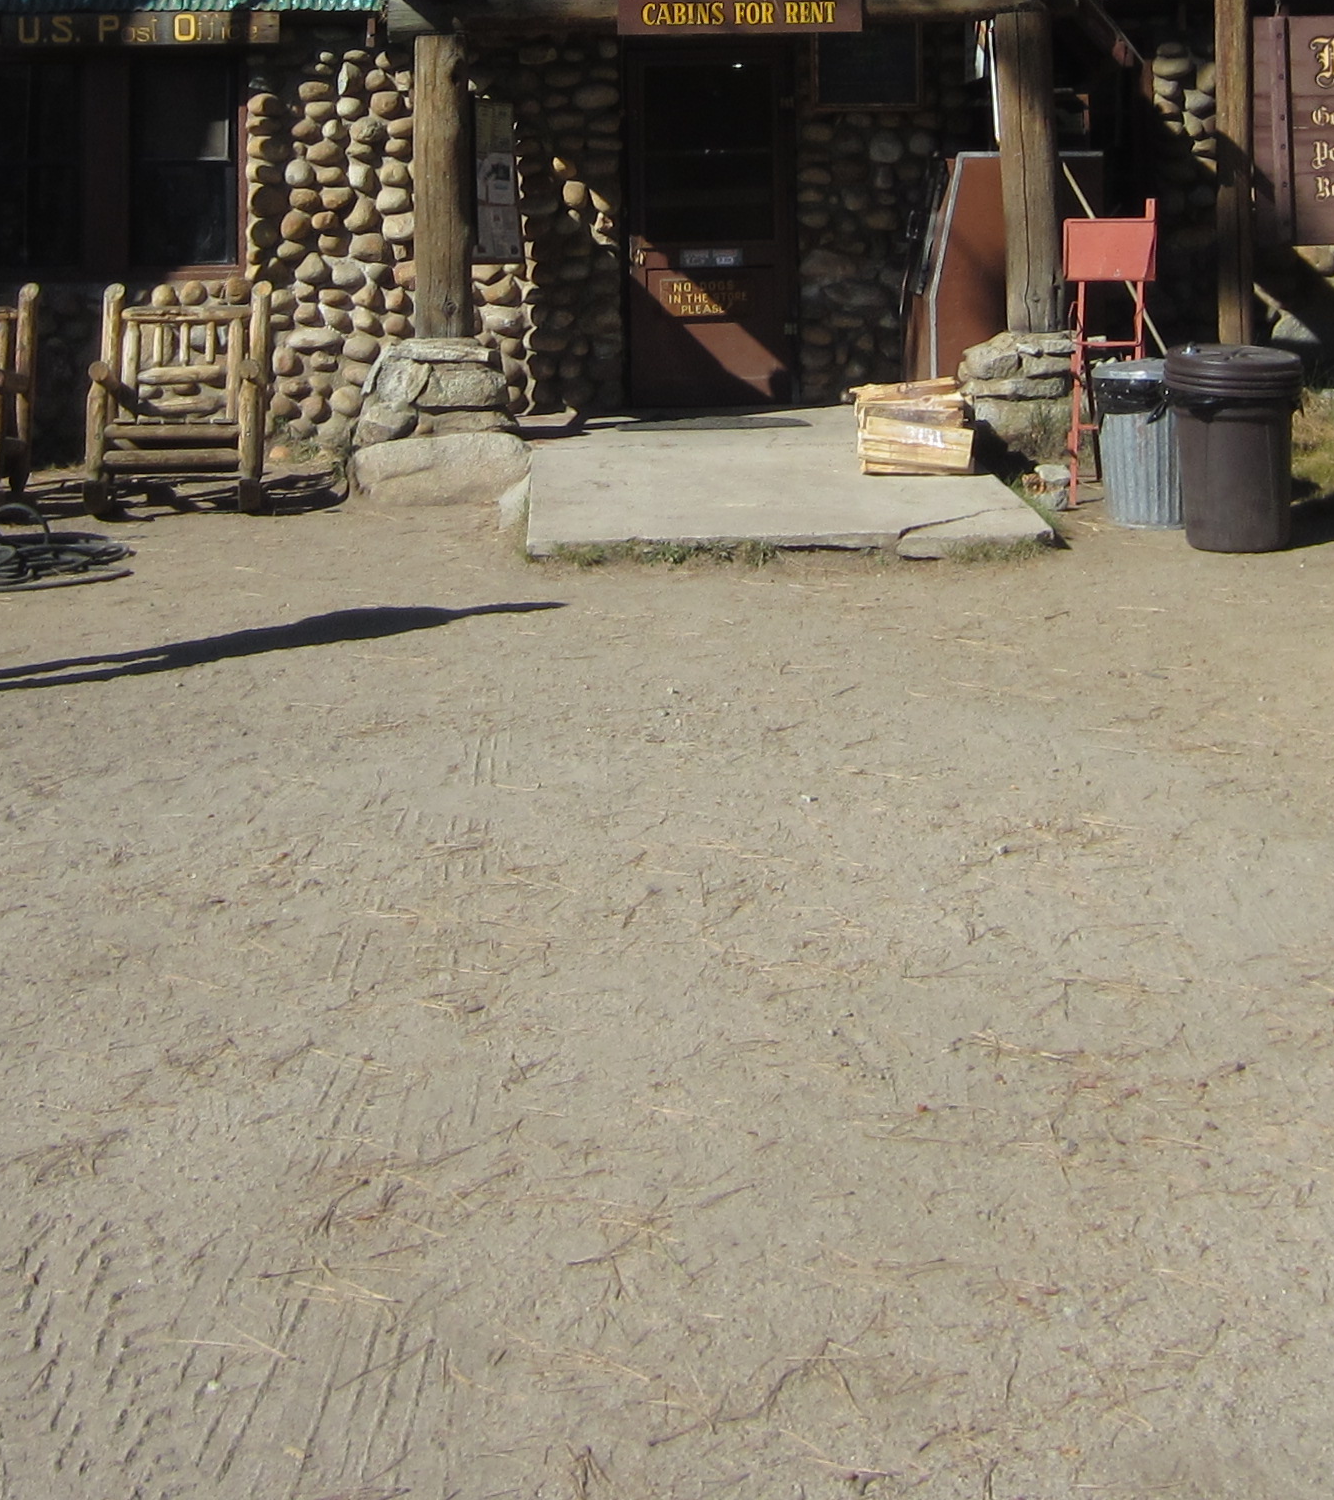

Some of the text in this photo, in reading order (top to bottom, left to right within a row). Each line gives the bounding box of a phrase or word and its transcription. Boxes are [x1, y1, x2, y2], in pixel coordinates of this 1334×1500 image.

[641, 0, 836, 26] CABINS FOR RENT
[18, 13, 258, 44] U.S. Post Office
[673, 282, 692, 292] NO
[668, 293, 681, 304] IN
[686, 293, 709, 303] THE
